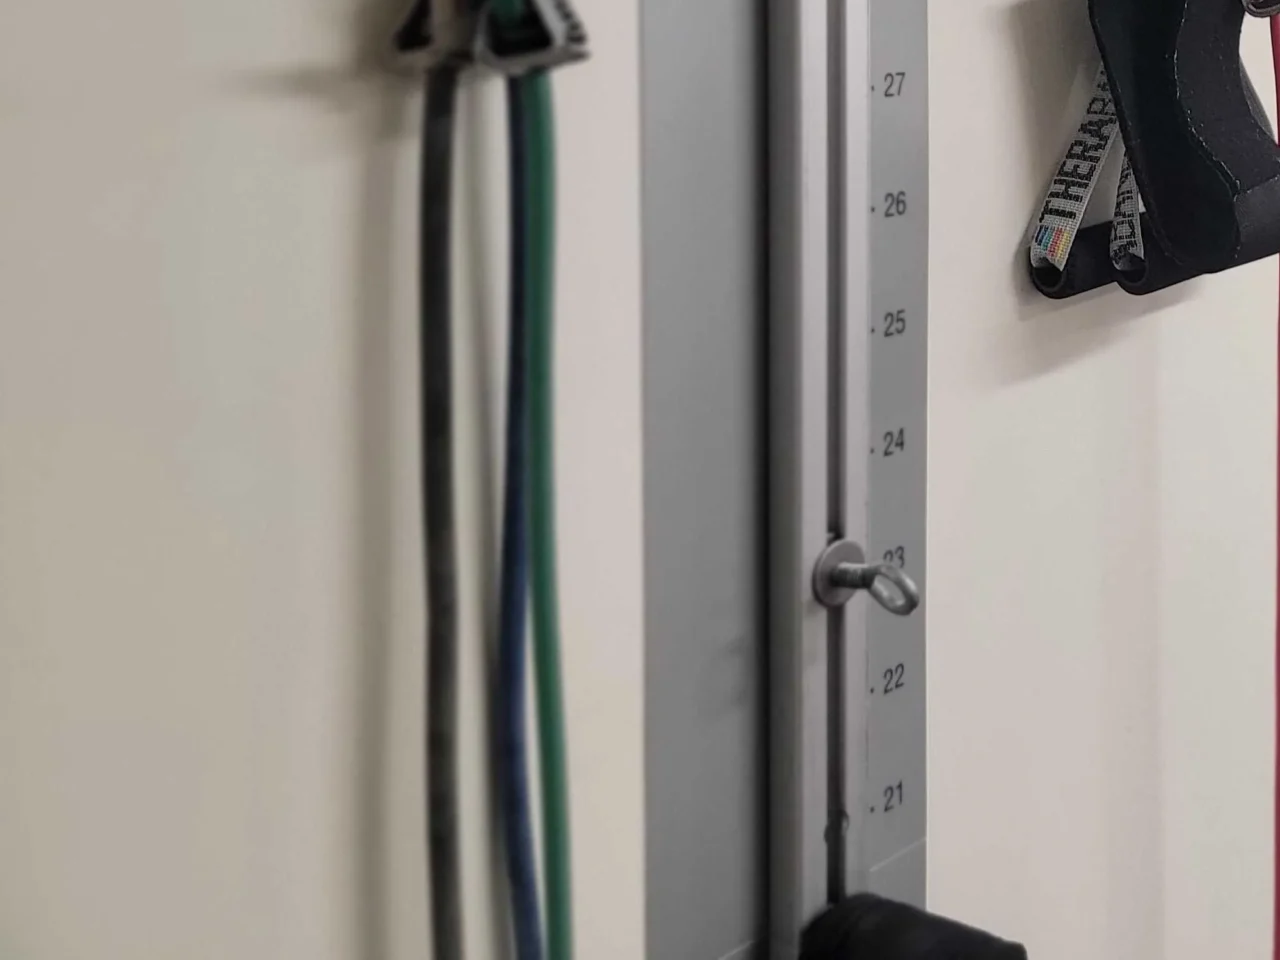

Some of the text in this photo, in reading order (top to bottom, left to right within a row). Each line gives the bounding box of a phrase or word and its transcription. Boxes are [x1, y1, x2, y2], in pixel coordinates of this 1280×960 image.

[884, 72, 905, 97] 27
[1039, 82, 1117, 223] THERAB
[884, 191, 906, 218] 26
[884, 309, 905, 337] 25
[883, 427, 905, 457] 24
[883, 663, 905, 694] 22
[883, 779, 904, 813] 21
